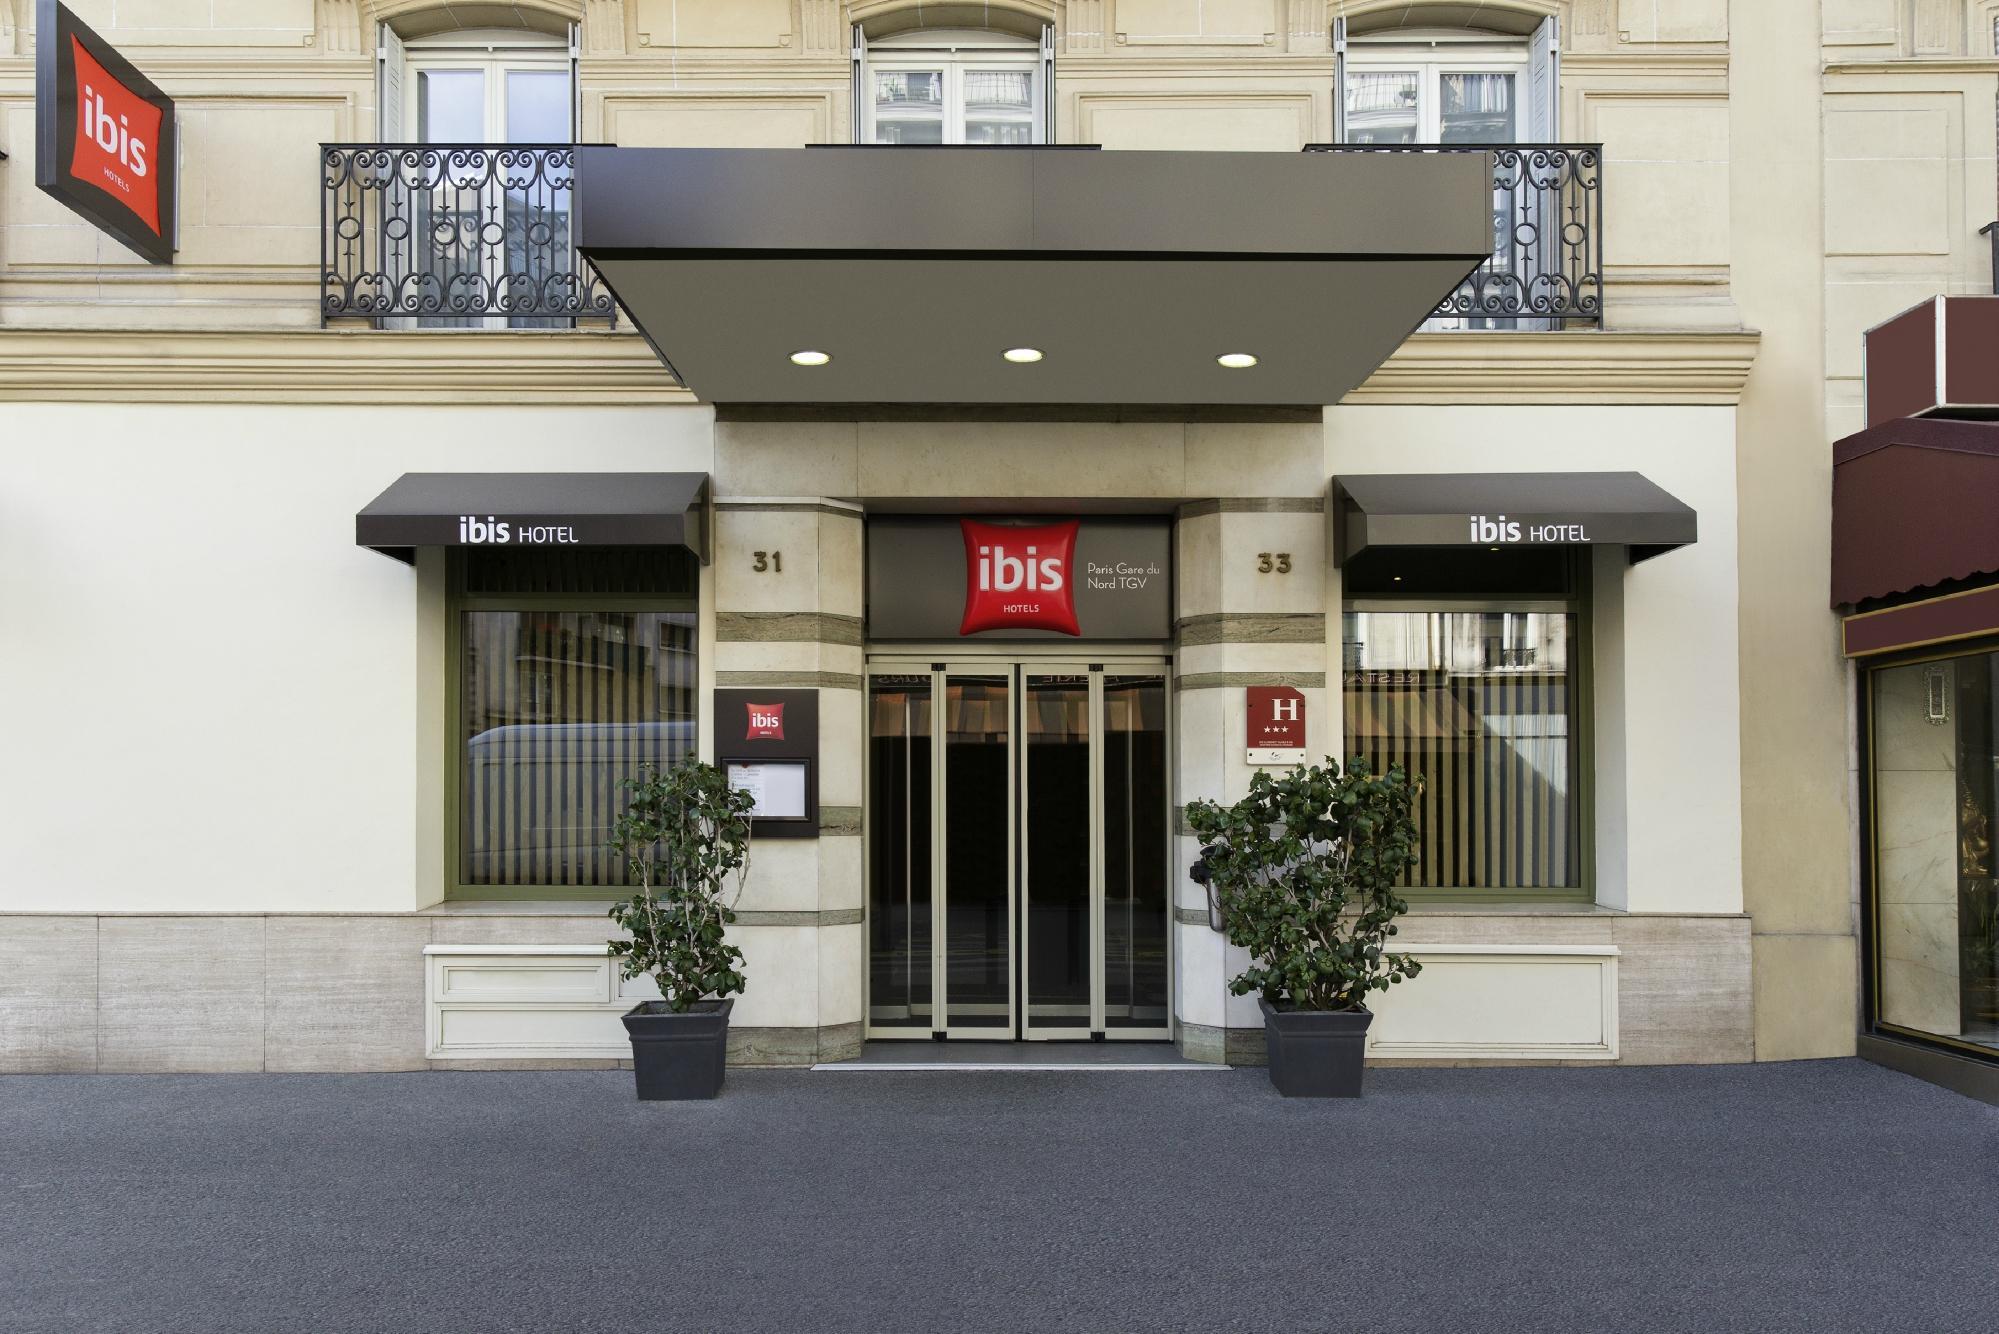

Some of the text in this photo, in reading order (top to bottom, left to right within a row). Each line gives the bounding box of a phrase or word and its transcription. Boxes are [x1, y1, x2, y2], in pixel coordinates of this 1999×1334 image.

[84, 84, 148, 178] ibis
[103, 166, 131, 193] HOTELS
[459, 515, 579, 544] ibis HOTEL
[1470, 515, 1591, 543] ibis HOTEL
[752, 550, 782, 573] 31
[979, 545, 1063, 592] ibis
[1087, 562, 1160, 575] Paris Gare du
[1257, 552, 1293, 574] 33
[1087, 577, 1147, 590] Nord TGV
[1003, 604, 1040, 613] HOTELS
[752, 712, 779, 728] ibis
[1271, 698, 1300, 721] H
